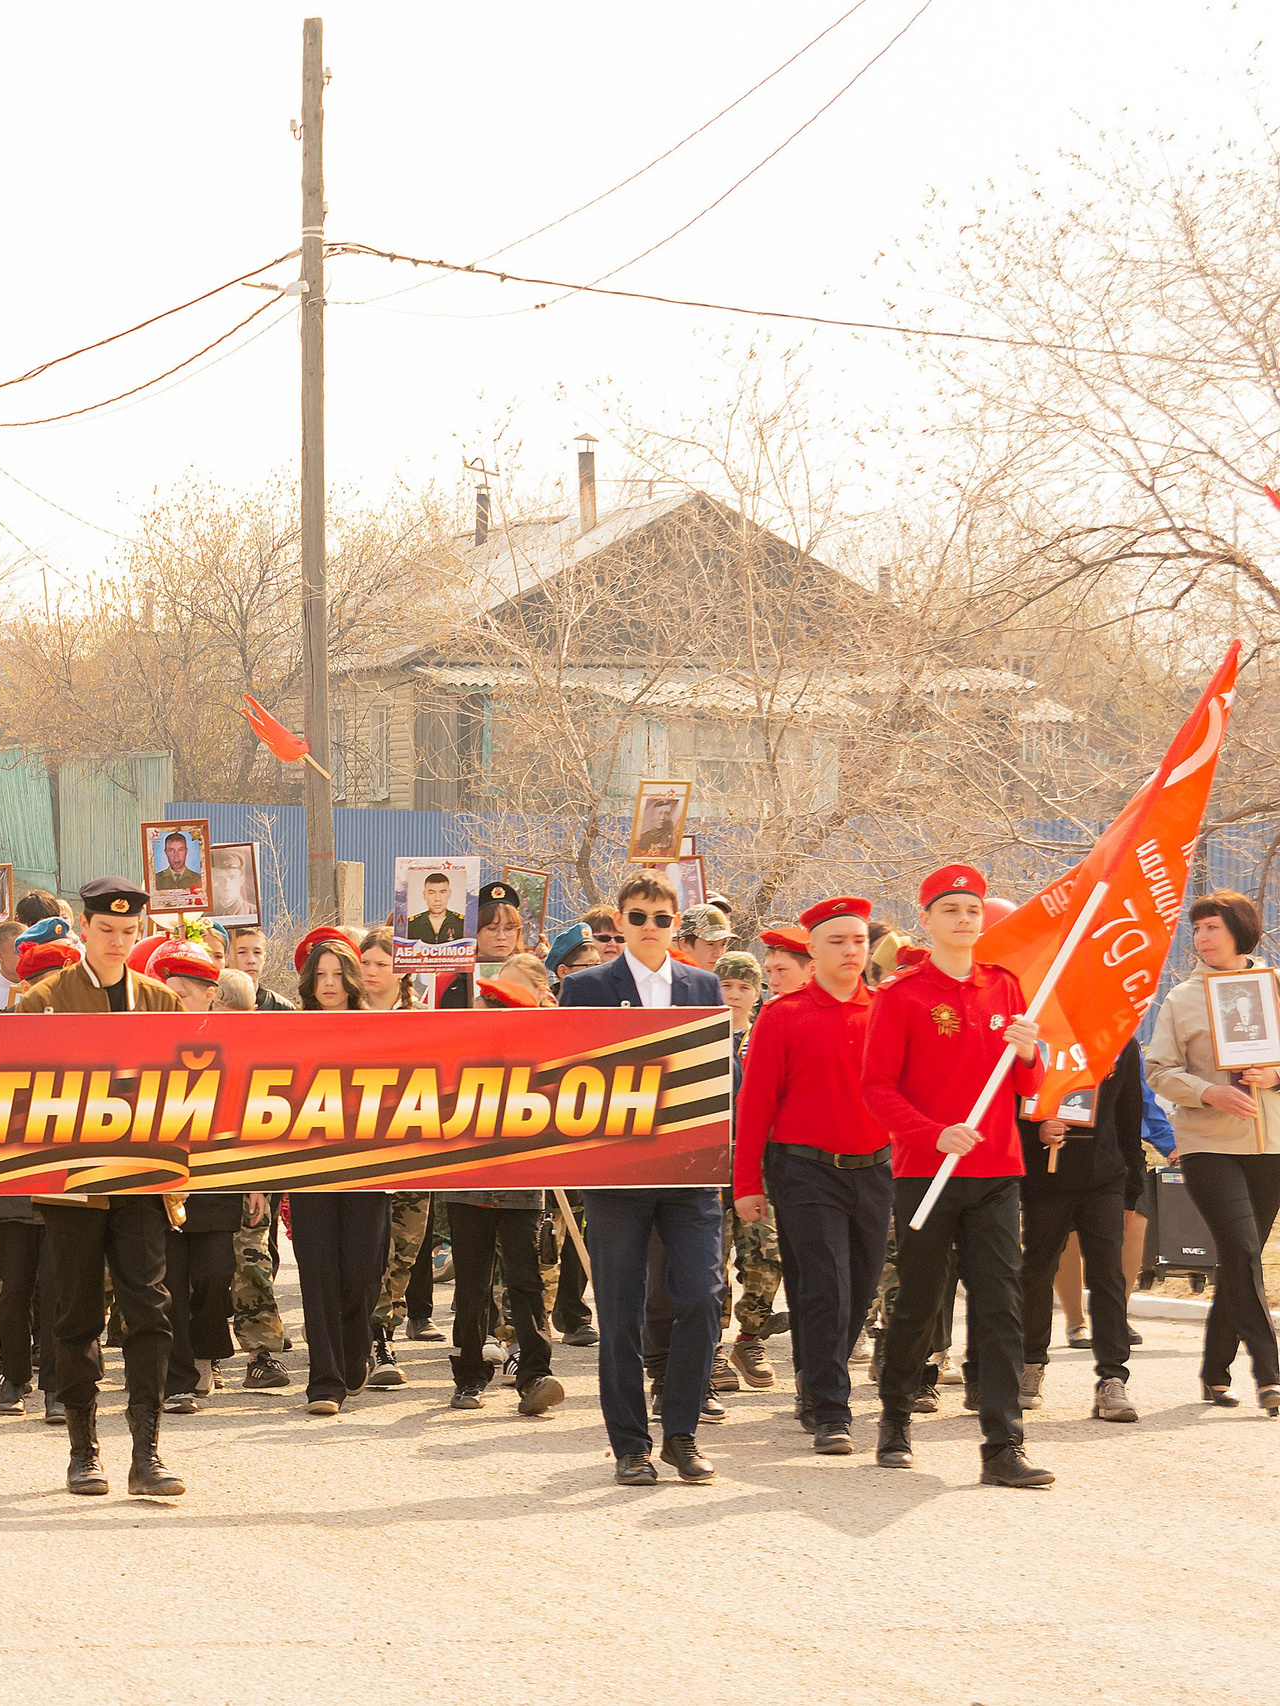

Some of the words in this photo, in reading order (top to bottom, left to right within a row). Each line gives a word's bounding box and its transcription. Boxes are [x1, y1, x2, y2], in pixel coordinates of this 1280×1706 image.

[395, 946, 475, 957] АБРОСИМОВ
[1091, 899, 1150, 967] 79
[423, 956, 475, 964] Анатольевич
[239, 1064, 664, 1141] БАТАЛЬОН
